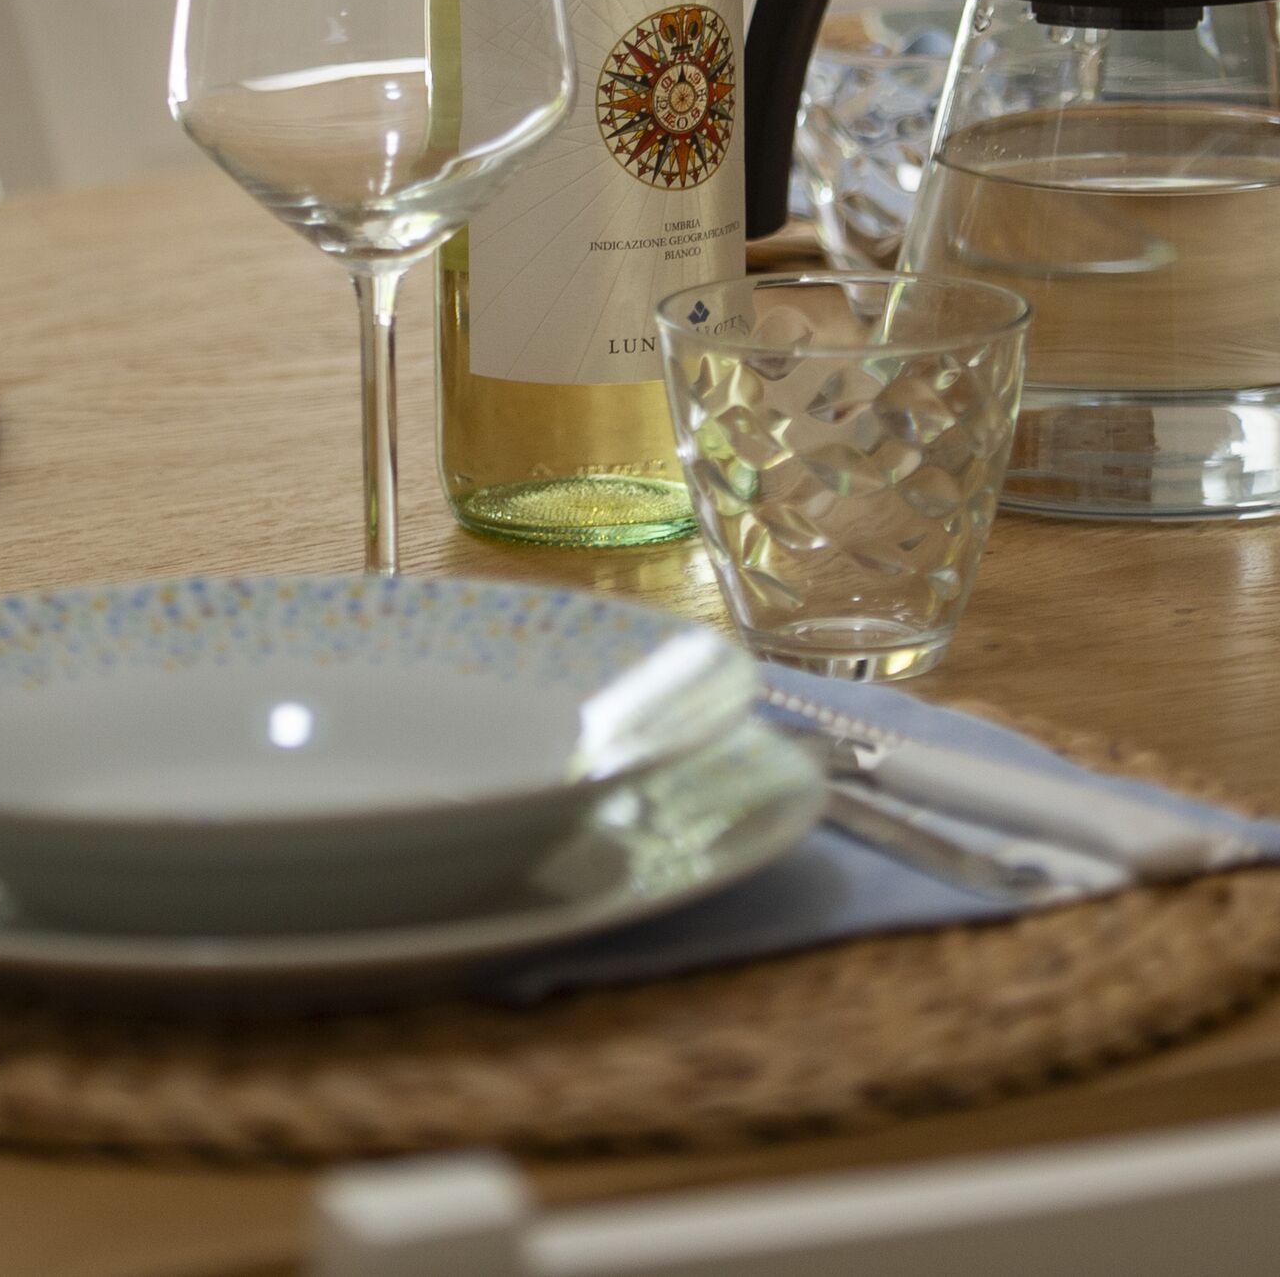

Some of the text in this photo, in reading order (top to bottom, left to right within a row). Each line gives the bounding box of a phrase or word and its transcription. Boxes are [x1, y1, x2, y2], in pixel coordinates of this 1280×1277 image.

[664, 218, 701, 232] UMBRIA
[589, 237, 667, 251] INDICAZIONE
[669, 226, 724, 246] GEOGRAFICA
[664, 247, 701, 261] BIANCO
